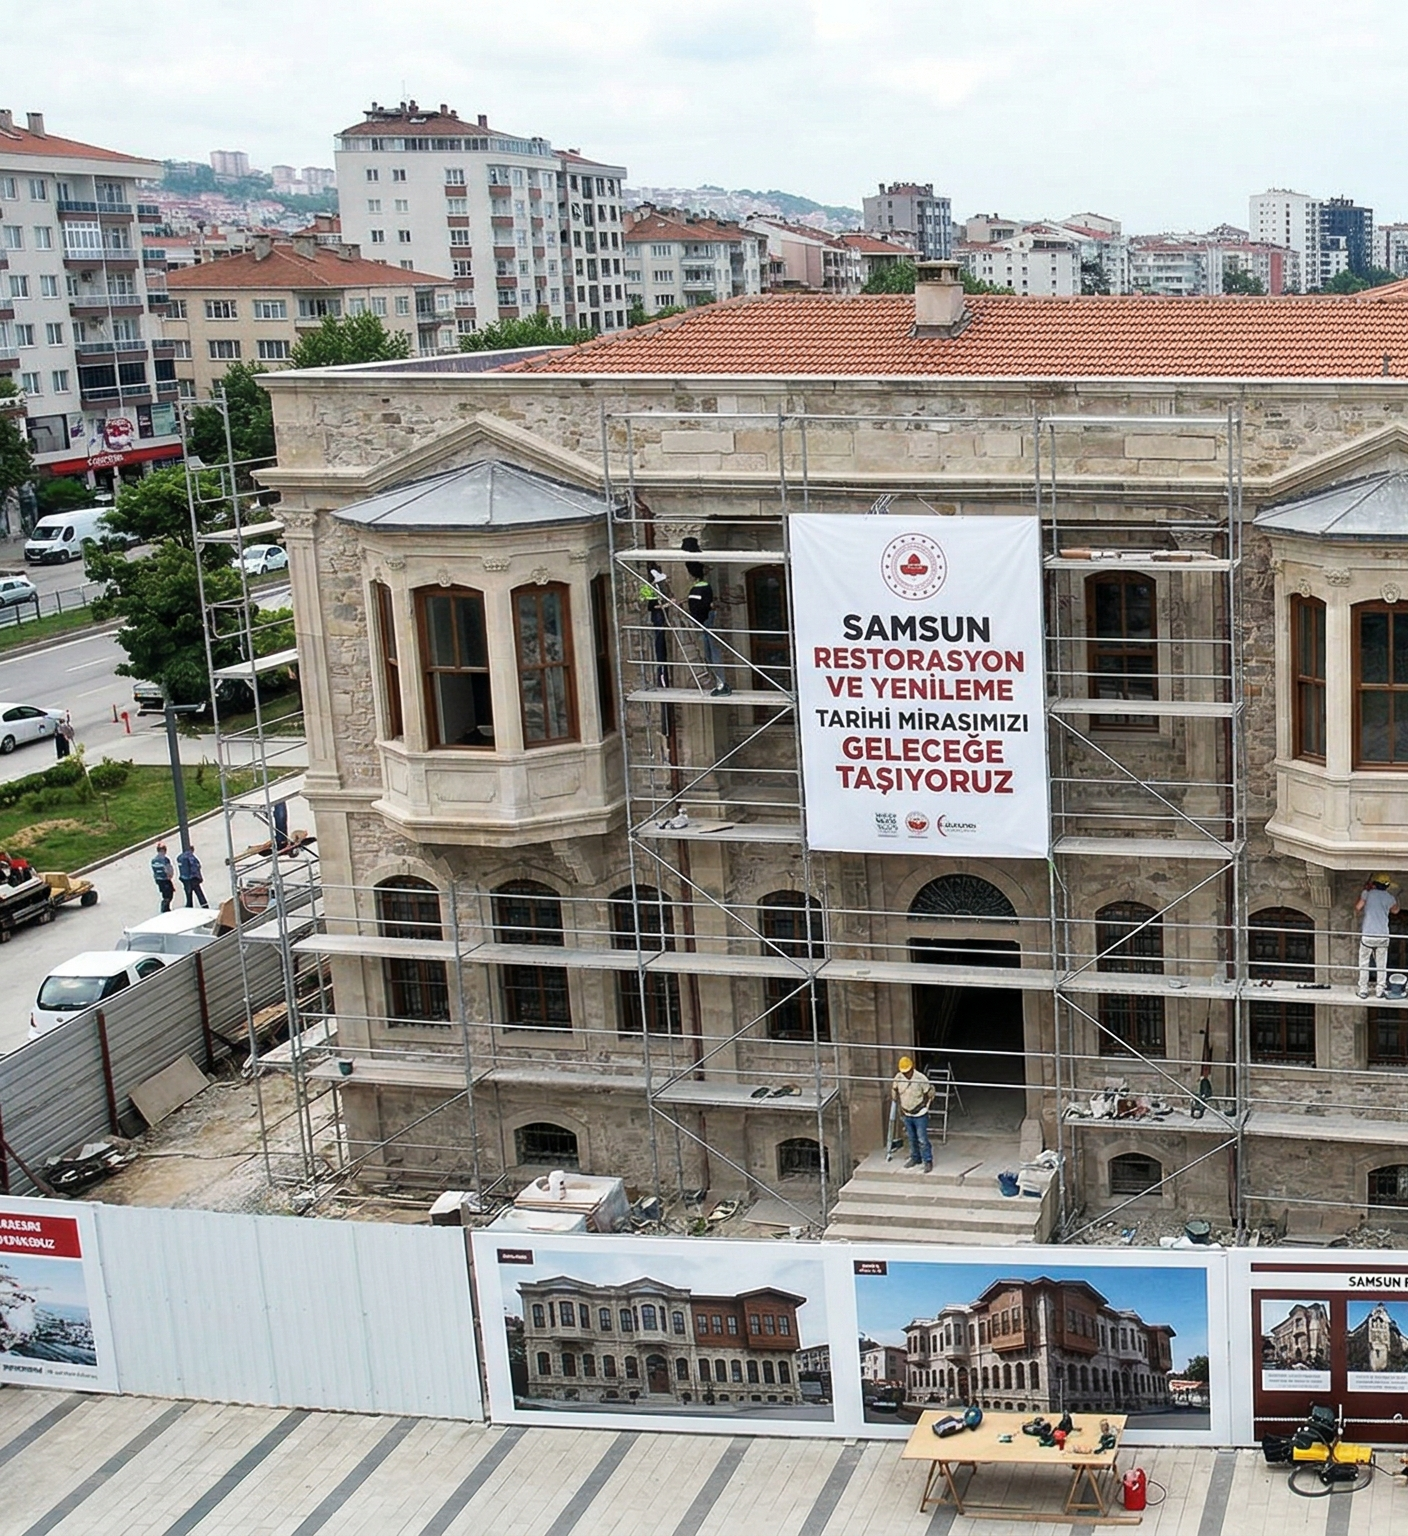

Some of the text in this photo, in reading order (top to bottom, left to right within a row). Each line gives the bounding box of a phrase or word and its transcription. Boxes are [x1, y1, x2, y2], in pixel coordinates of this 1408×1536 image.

[843, 614, 990, 642] SAMSUN
[813, 647, 1025, 672] RESTORASYON
[826, 673, 1013, 701] VE YENİLEME
[815, 706, 1028, 732] TARİHİ MİRASIMIZI
[842, 733, 1004, 763] GELECEĞE
[835, 766, 1014, 795] TAŞIYORUZ
[1349, 1276, 1401, 1288] SAMSUN
